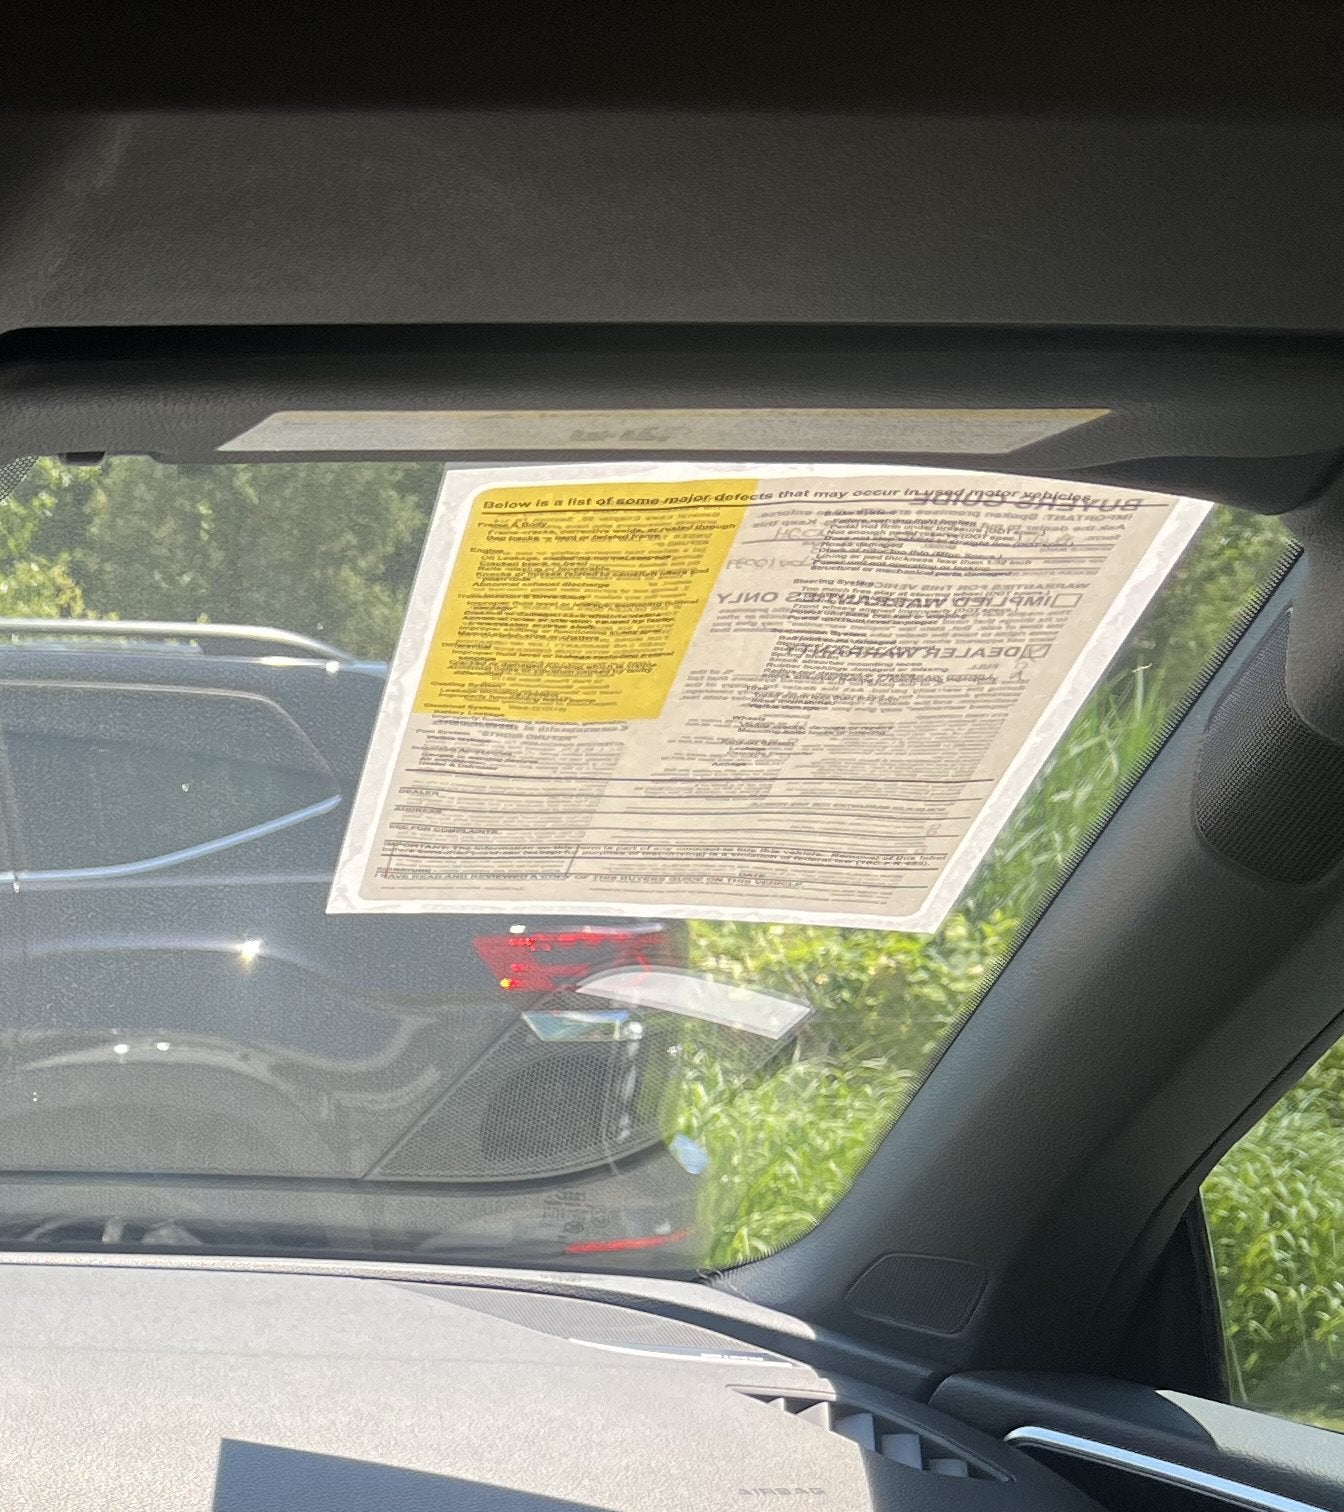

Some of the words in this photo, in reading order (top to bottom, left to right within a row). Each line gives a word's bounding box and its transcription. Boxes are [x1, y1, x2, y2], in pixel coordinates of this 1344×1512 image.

[482, 500, 531, 510] Below
[534, 499, 550, 508] is
[567, 497, 592, 507] list
[595, 496, 613, 506] of
[614, 496, 660, 506] some
[663, 493, 712, 507] major
[714, 490, 774, 503] defects
[778, 489, 811, 499] that
[813, 490, 848, 503] may
[852, 488, 900, 499] occur
[904, 488, 920, 497] in
[969, 489, 1018, 500] motor
